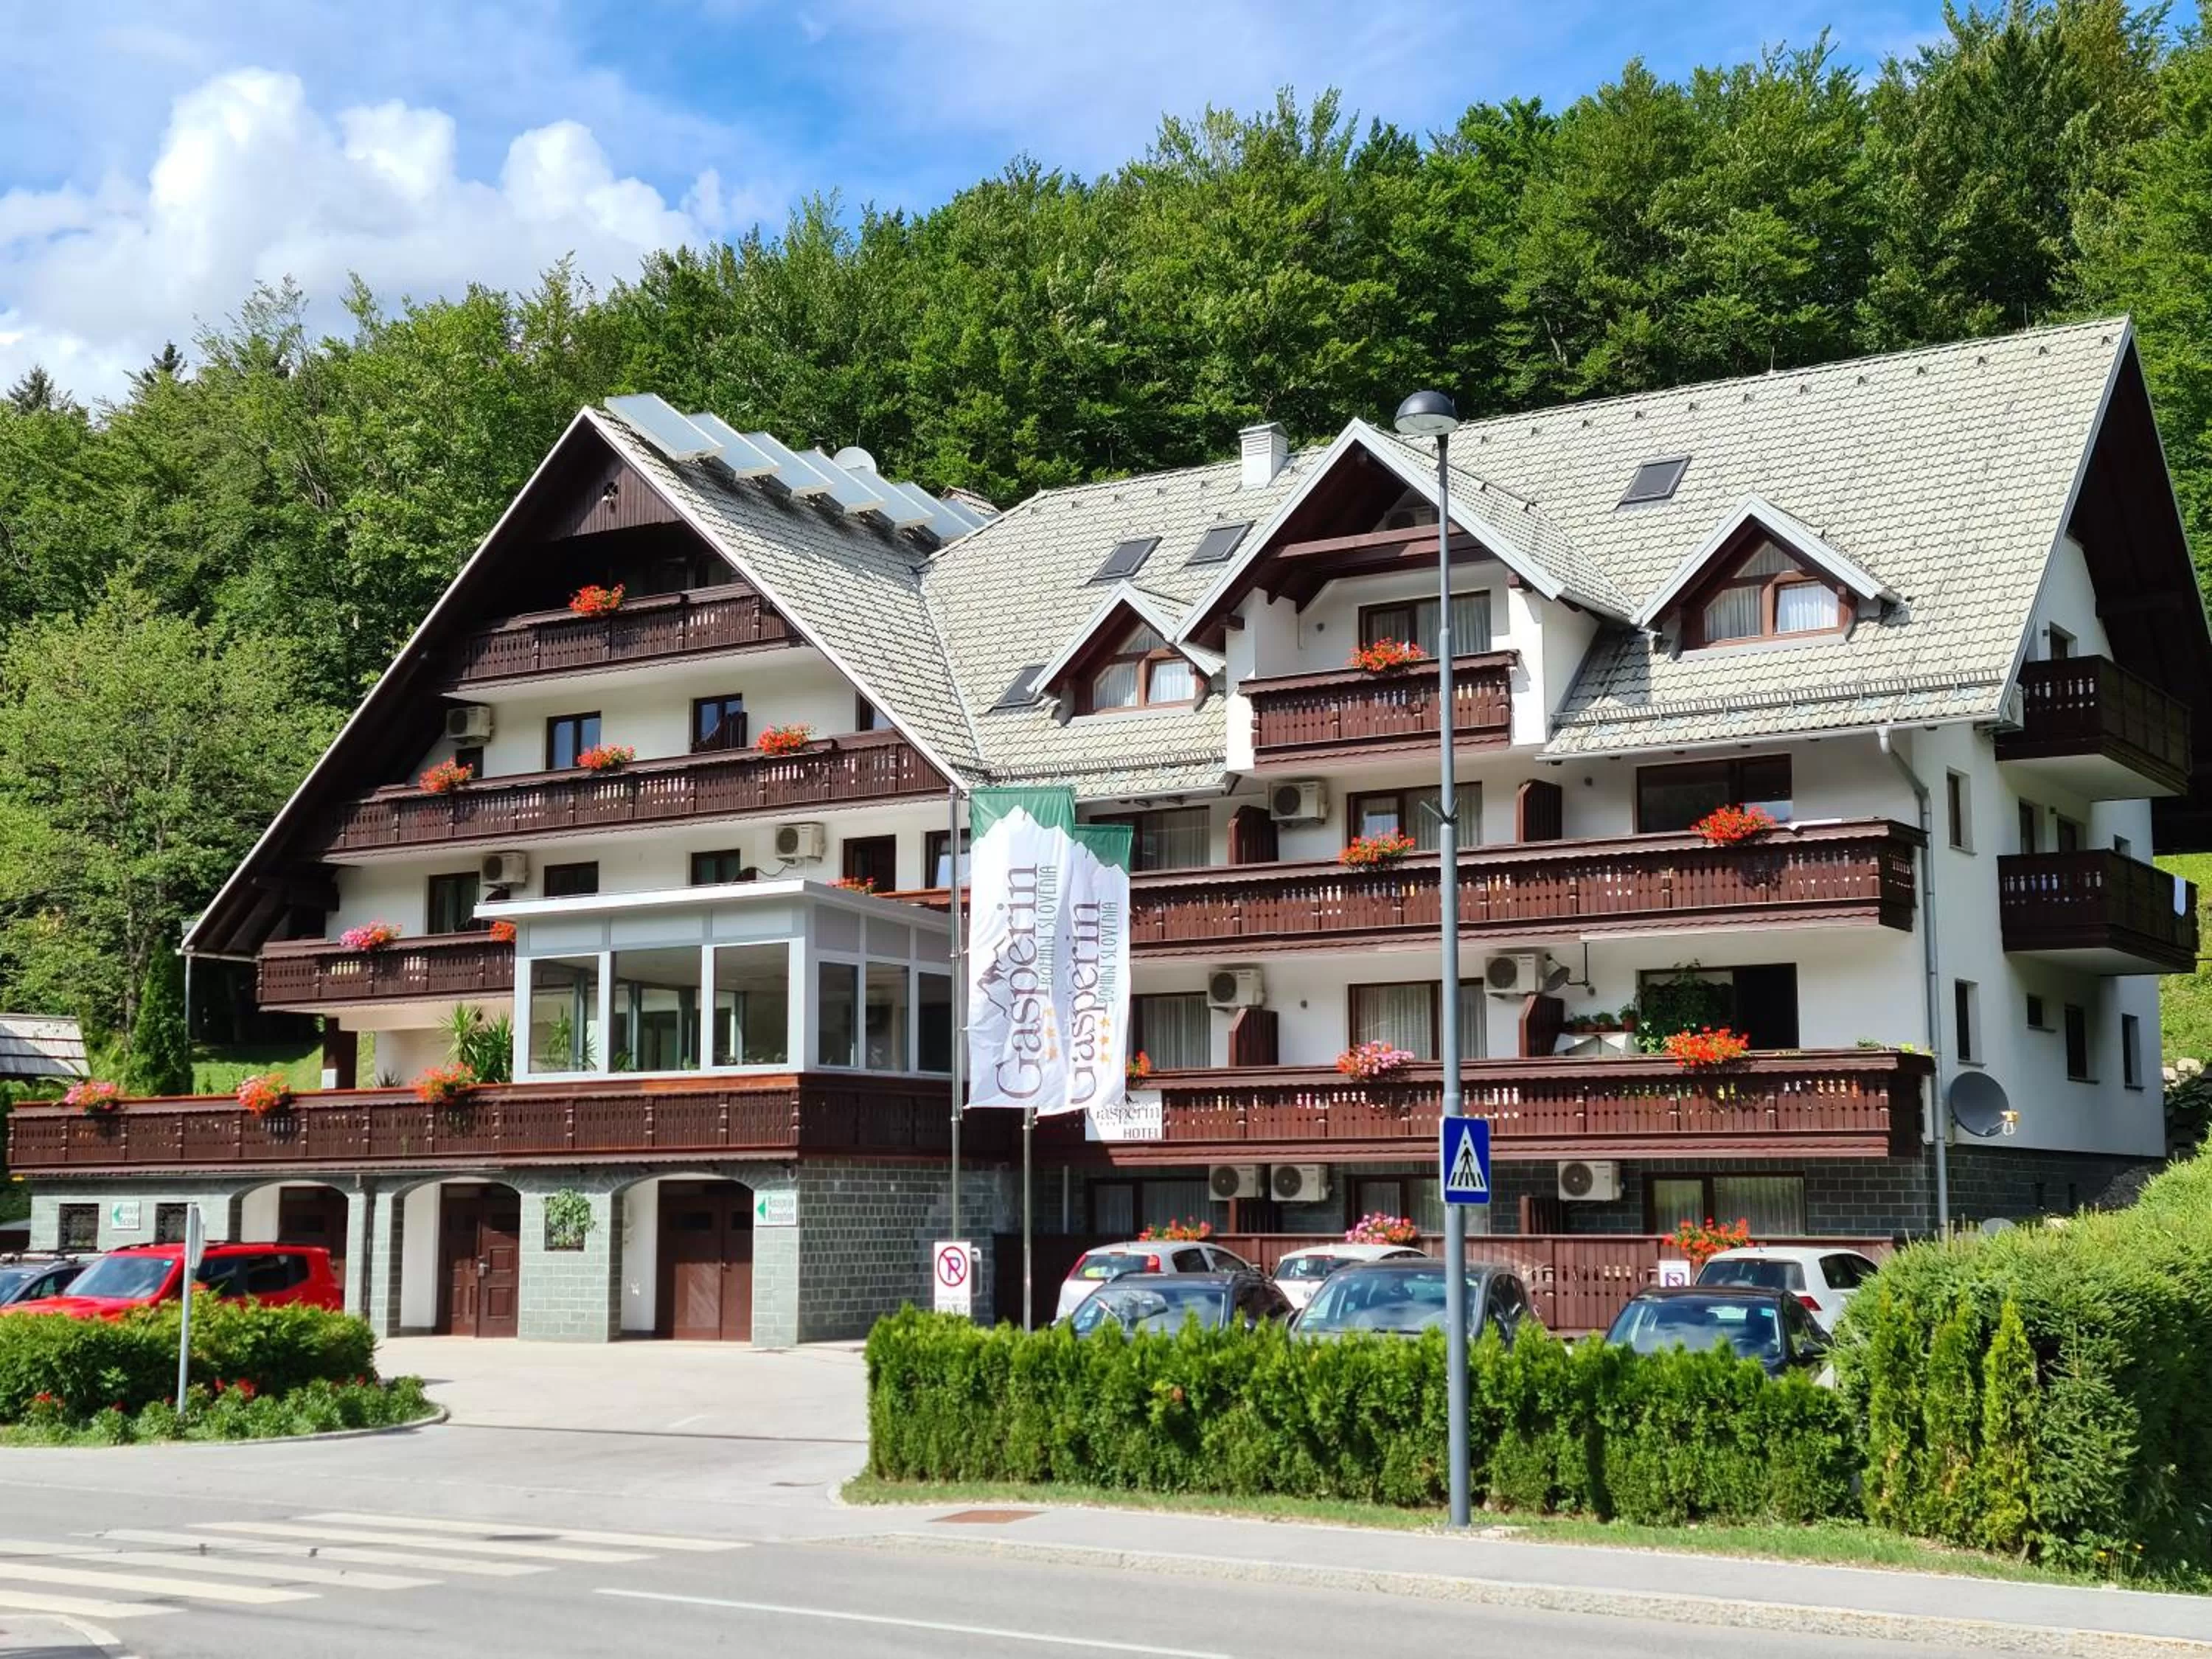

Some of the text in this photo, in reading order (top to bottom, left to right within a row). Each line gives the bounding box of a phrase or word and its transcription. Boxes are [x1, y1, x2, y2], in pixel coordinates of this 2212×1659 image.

[1037, 865, 1057, 986] BOHINJ SLOVENIA
[1099, 901, 1119, 959] SLOVENIA
[995, 863, 1048, 1099] Gasperin
[1124, 1127, 1158, 1139] HOTEL
